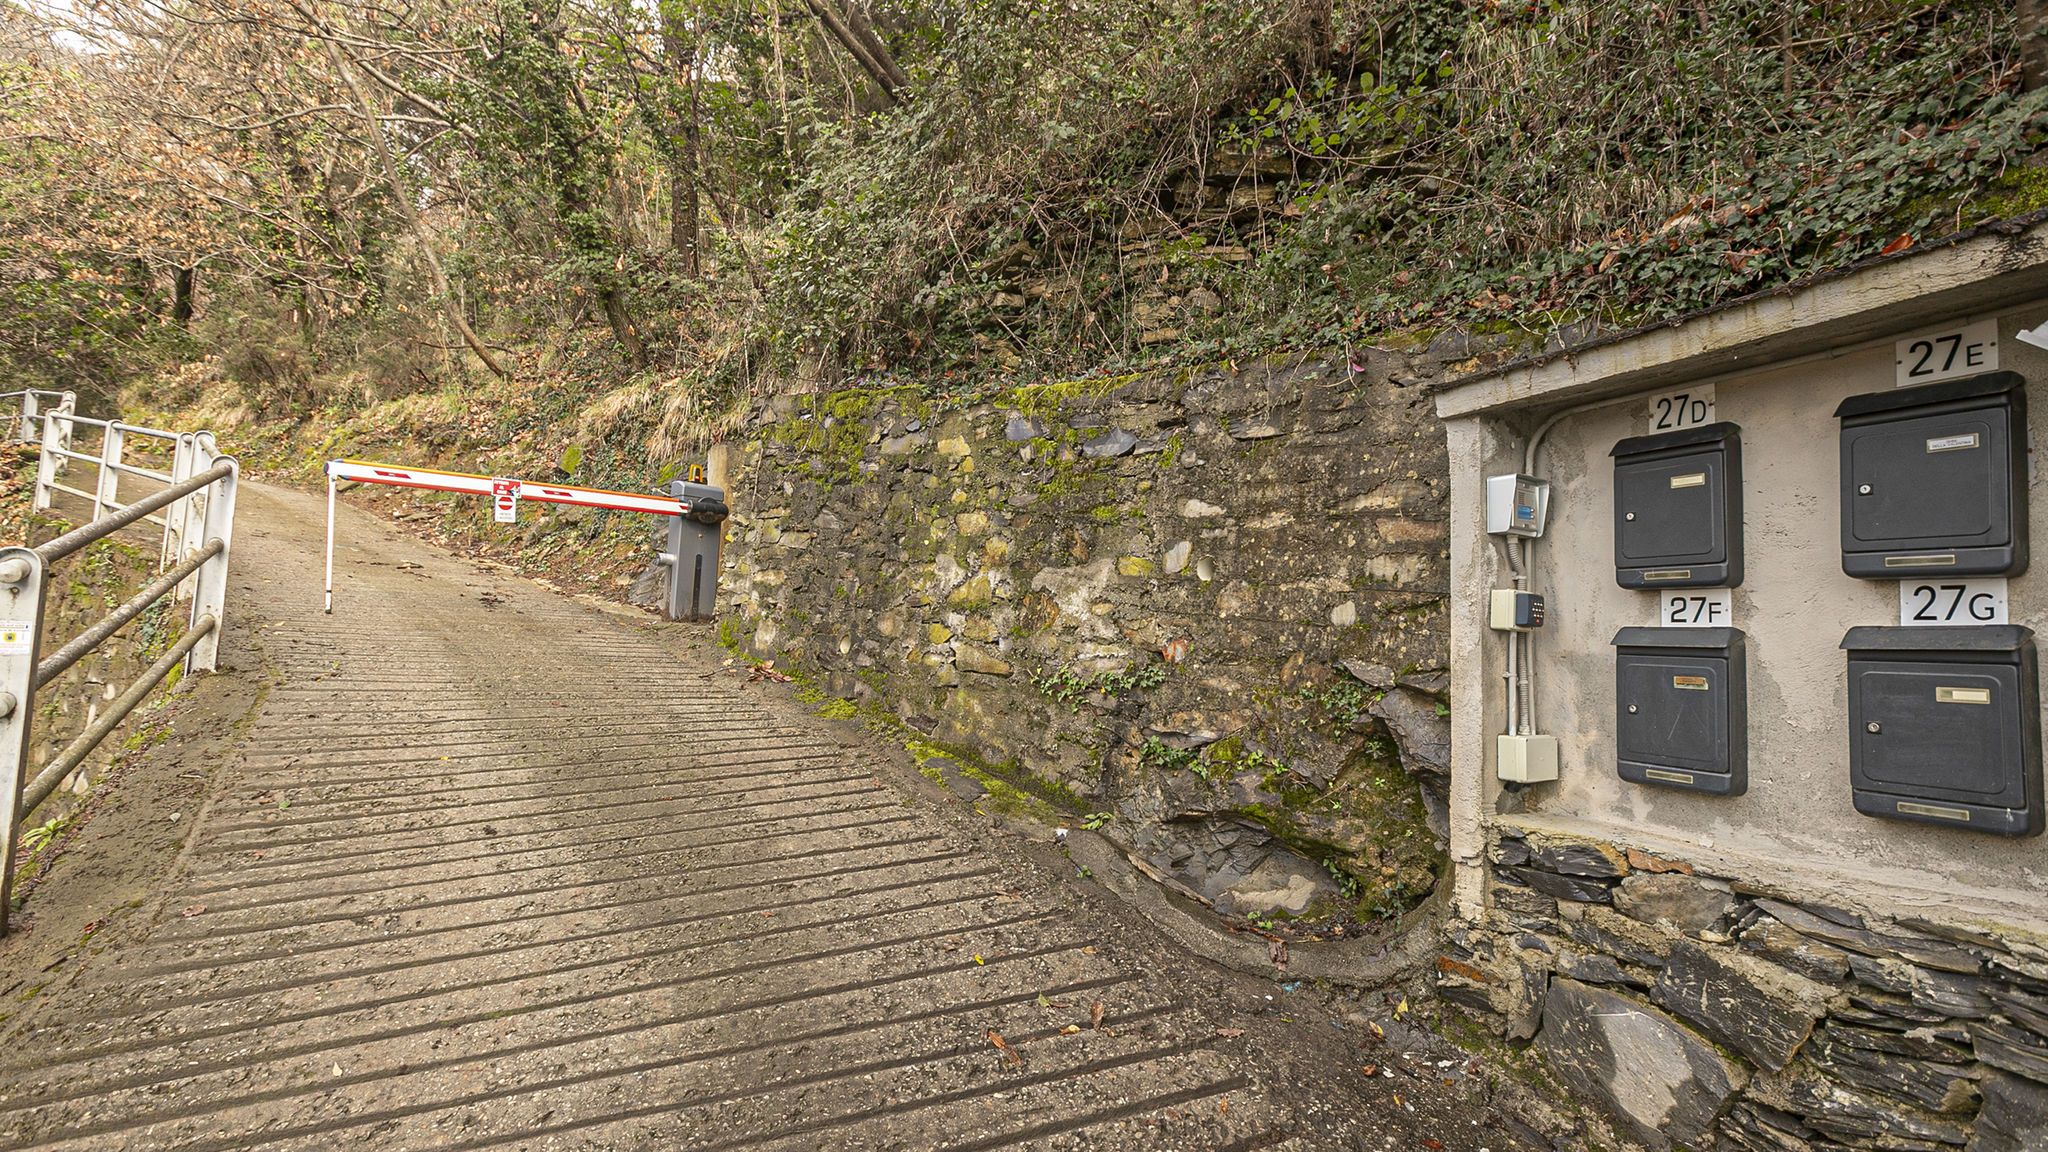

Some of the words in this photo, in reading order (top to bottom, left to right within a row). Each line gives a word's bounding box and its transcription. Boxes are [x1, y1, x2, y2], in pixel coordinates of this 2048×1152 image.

[1908, 333, 1985, 377] 27E
[1656, 394, 1707, 429] 27D
[1670, 597, 1722, 623] 27F
[1913, 585, 1995, 621] 27G
